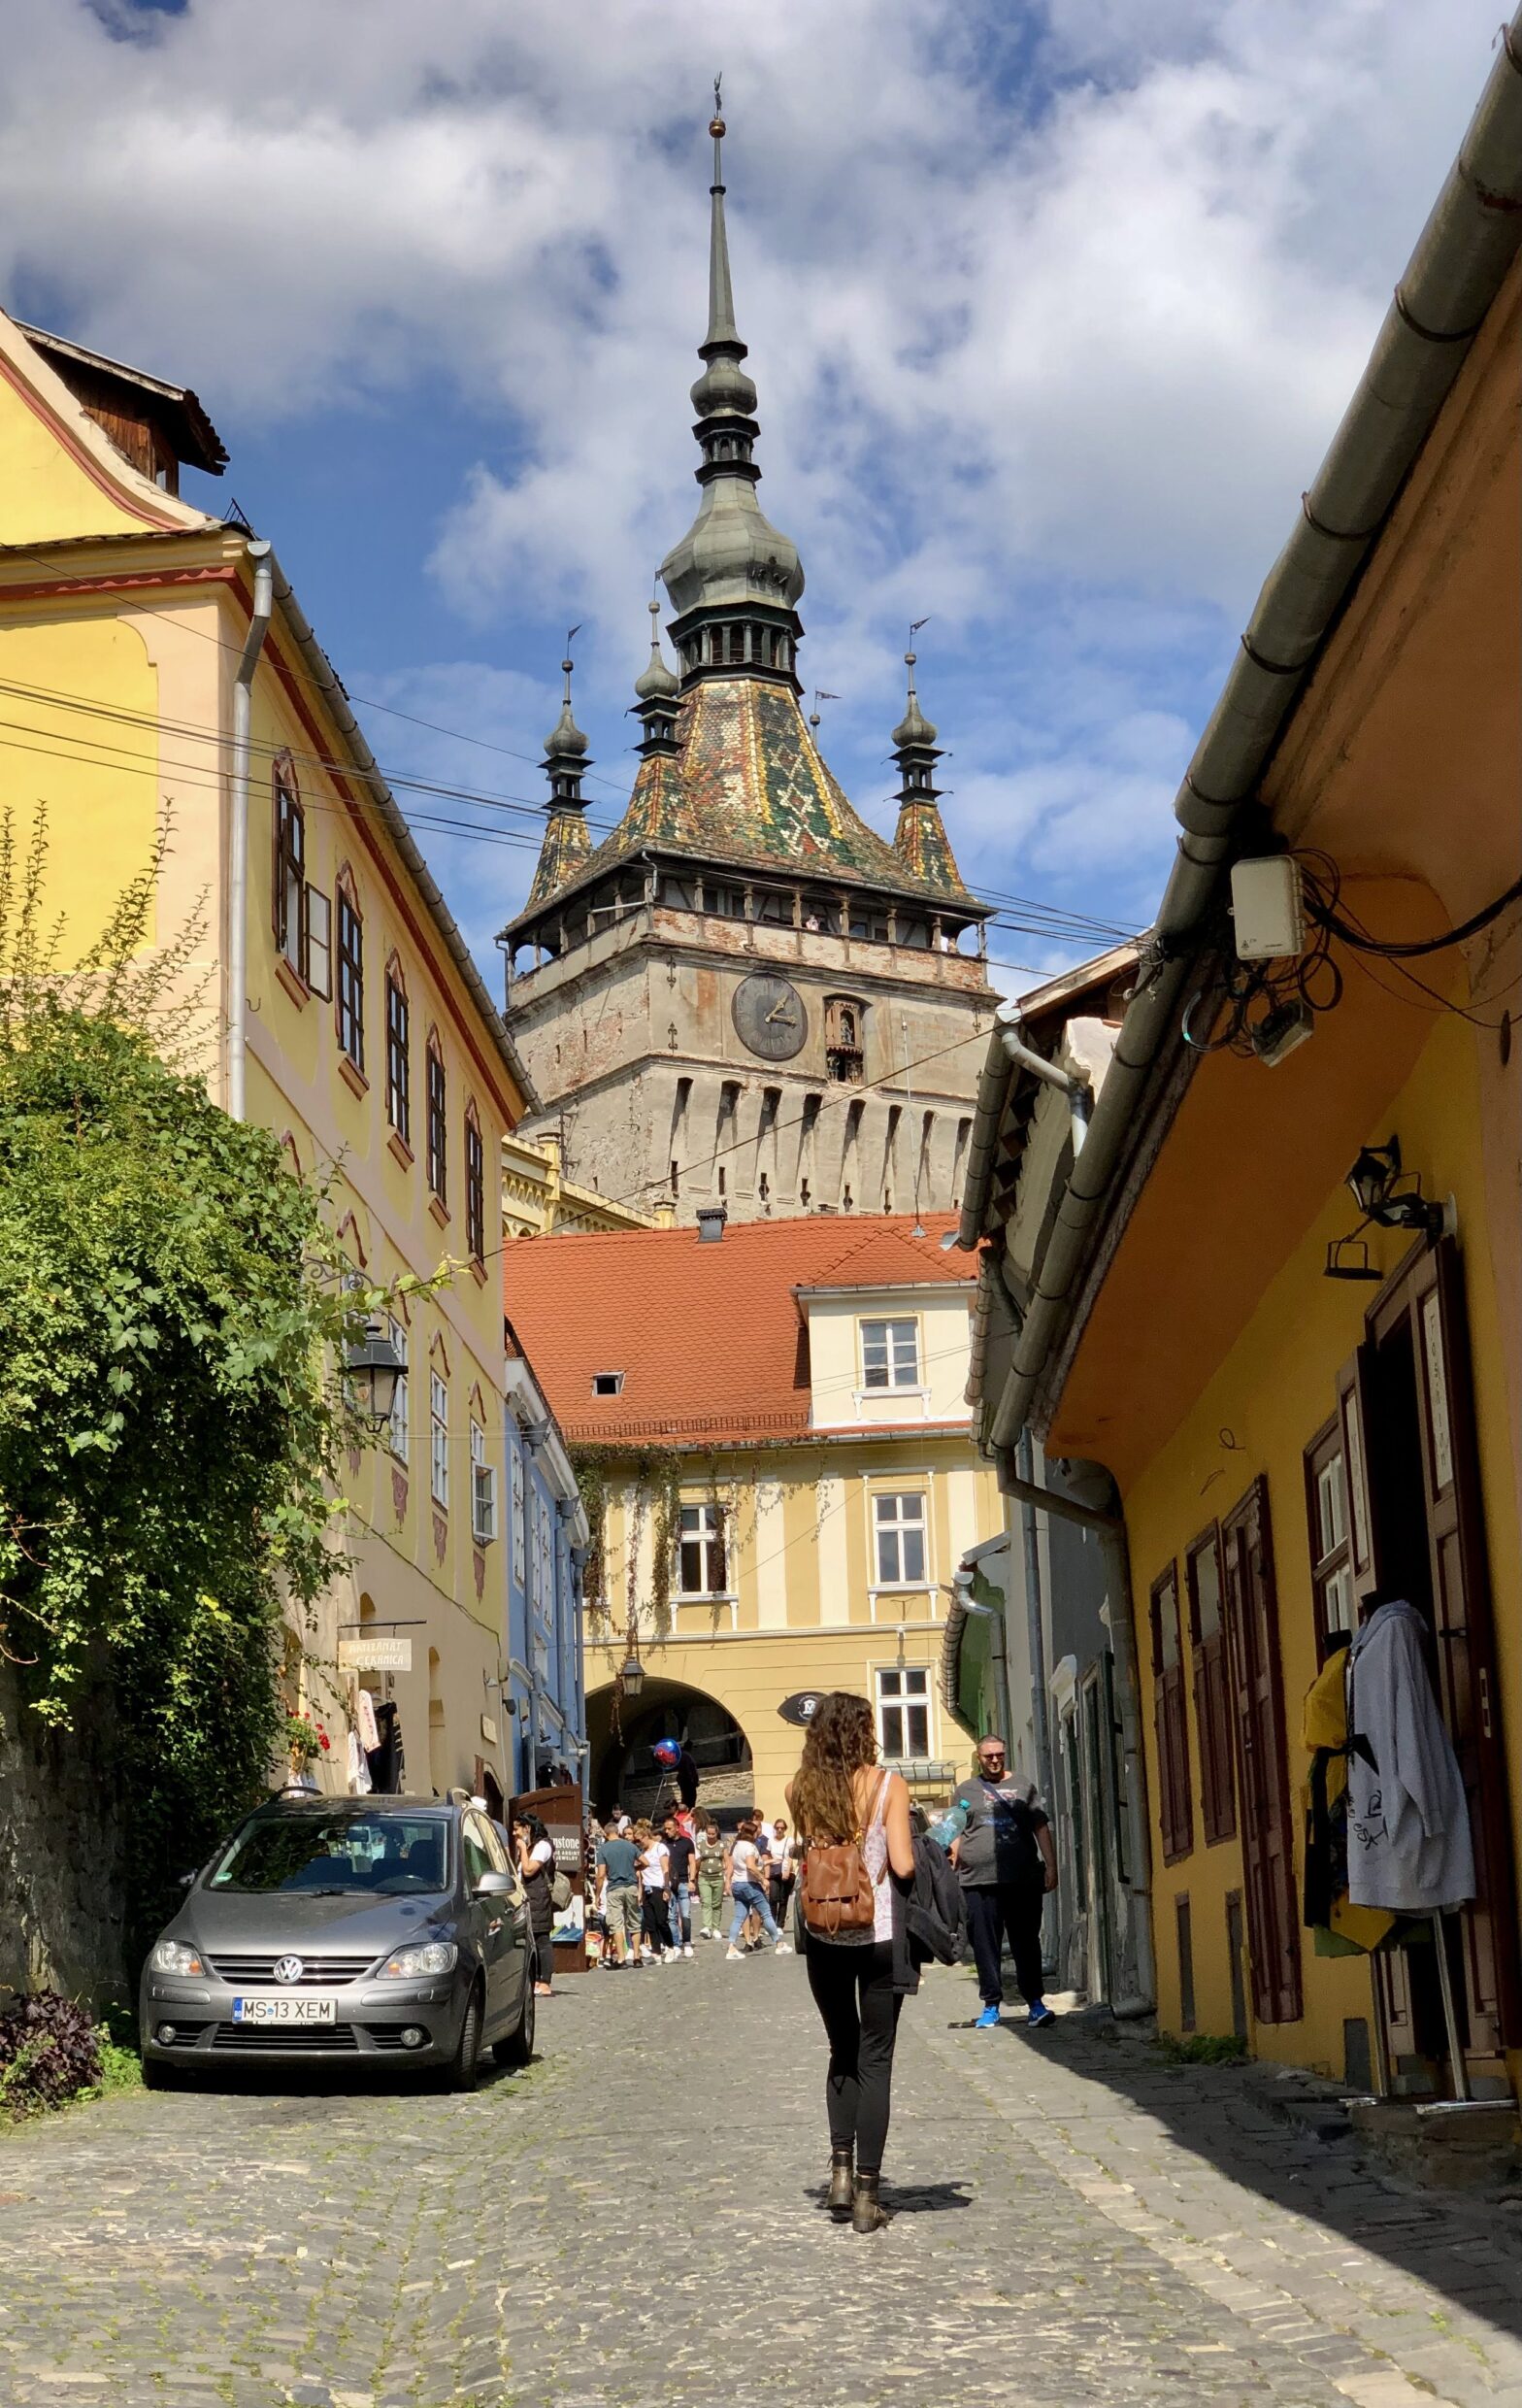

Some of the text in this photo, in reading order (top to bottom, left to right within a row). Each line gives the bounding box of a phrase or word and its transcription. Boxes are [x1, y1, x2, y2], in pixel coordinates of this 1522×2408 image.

[552, 1836, 579, 1849] nstone
[244, 2001, 267, 2019] MS
[273, 2001, 289, 2019] 13
[295, 2001, 330, 2019] XEM
